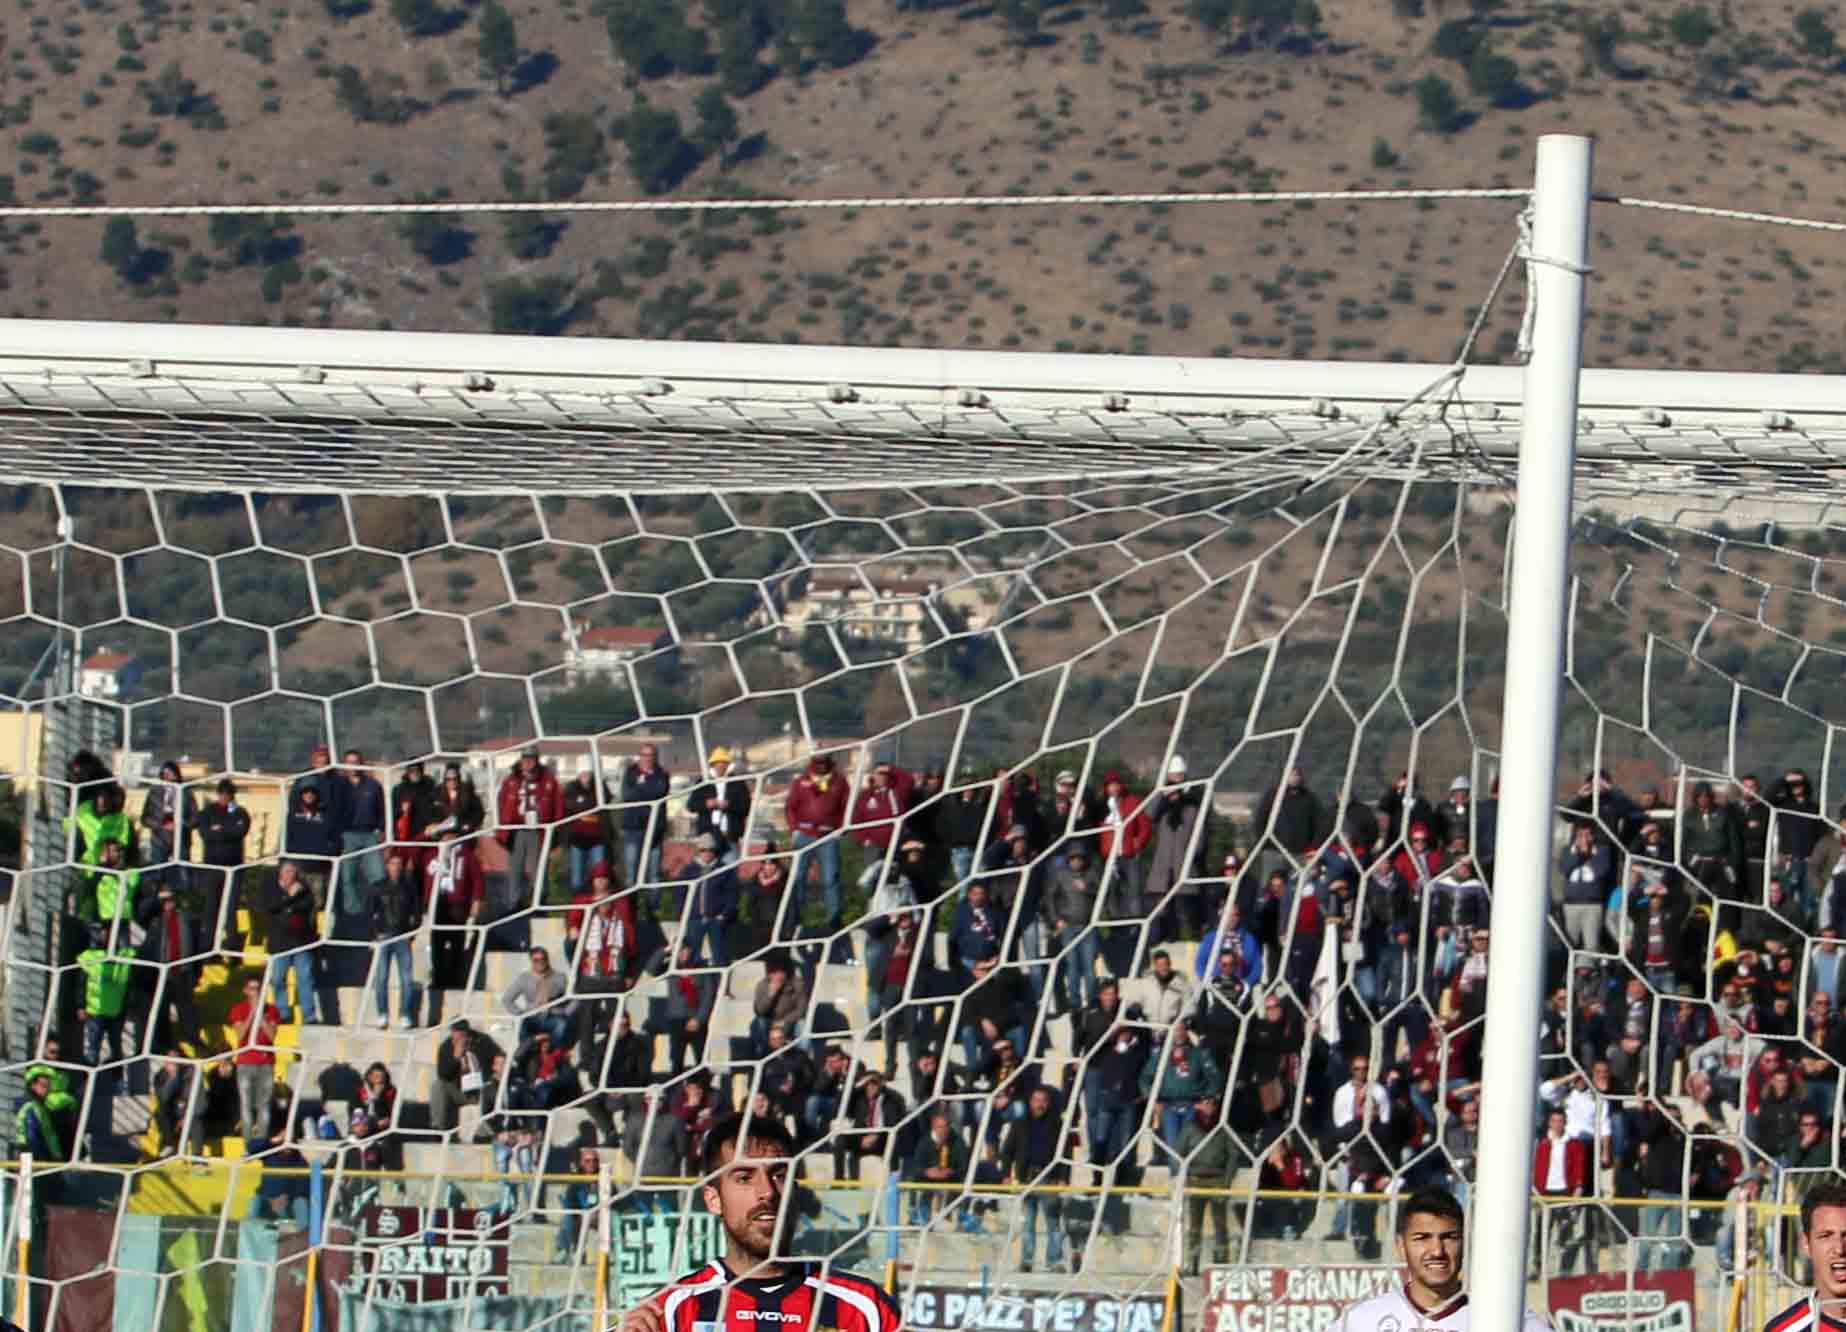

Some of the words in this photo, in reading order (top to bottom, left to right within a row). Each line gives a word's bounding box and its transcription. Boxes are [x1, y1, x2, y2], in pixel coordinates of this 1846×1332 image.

[380, 1246, 493, 1274] RAITO
[621, 1218, 657, 1274] SE
[1208, 1270, 1273, 1301] FEDE
[735, 1310, 801, 1323] GIVOVA
[943, 1294, 1026, 1329] PAZZ
